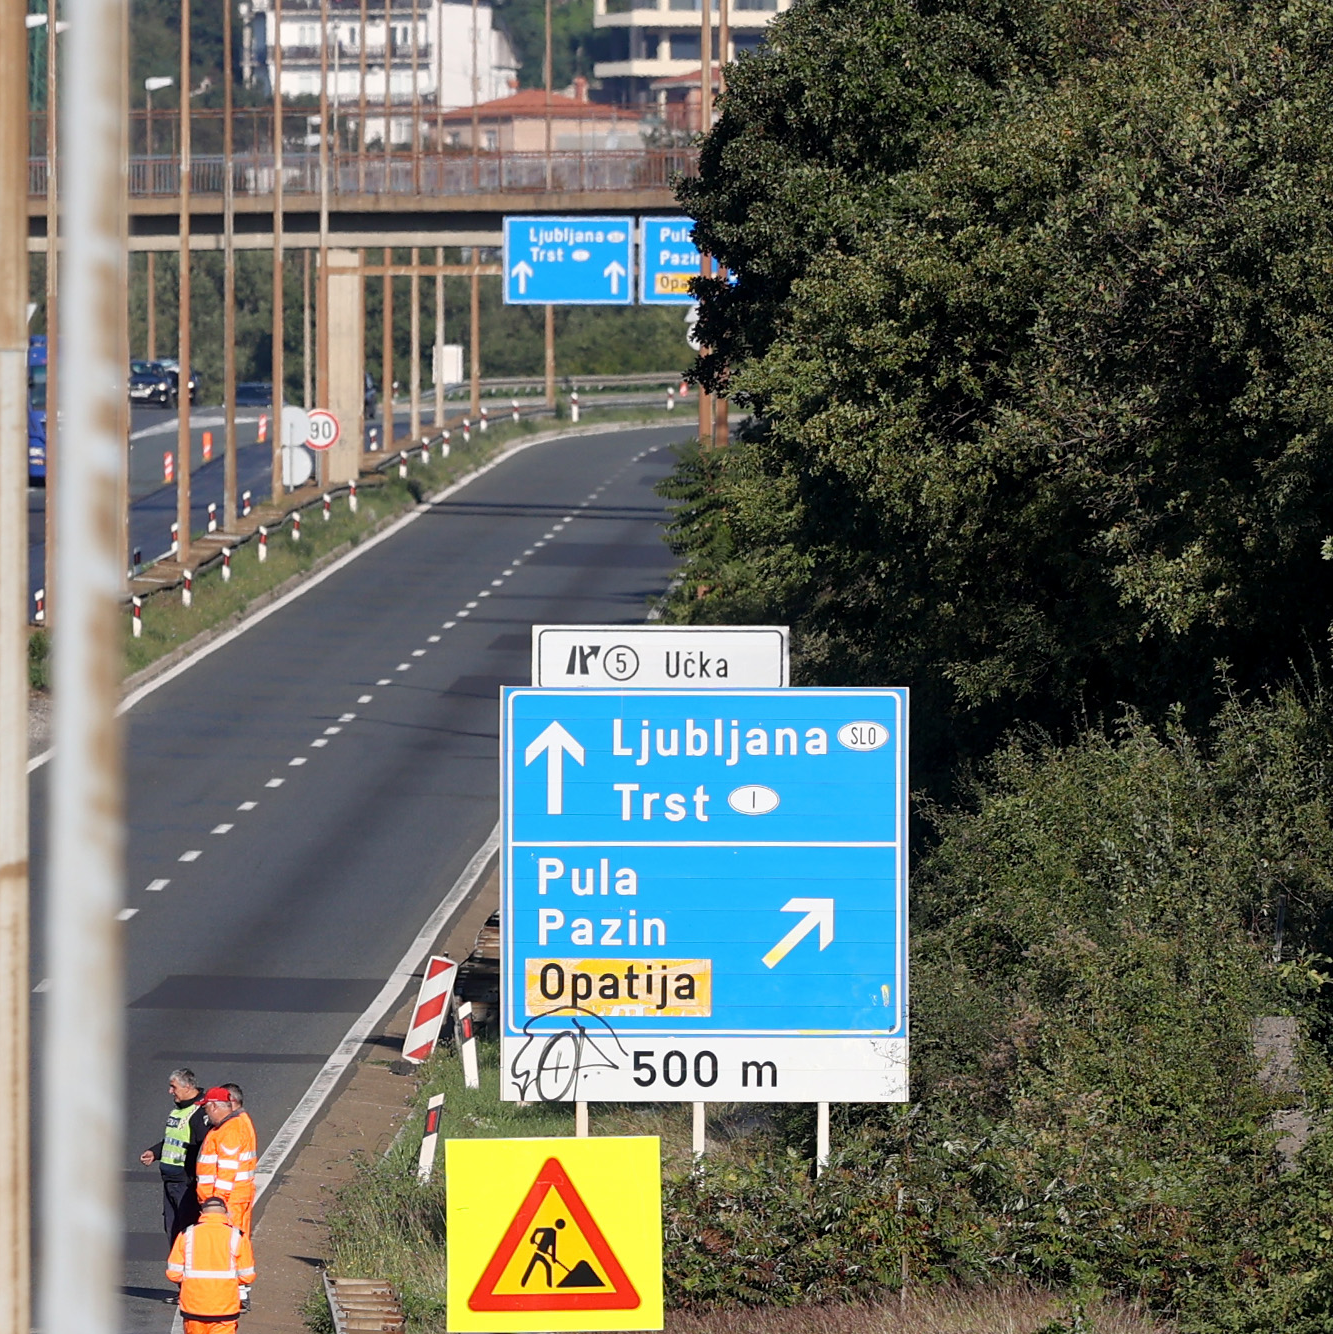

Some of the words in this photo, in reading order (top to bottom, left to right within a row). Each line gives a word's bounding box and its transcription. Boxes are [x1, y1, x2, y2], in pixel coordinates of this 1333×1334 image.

[529, 228, 604, 246] Ljubljana
[529, 247, 564, 262] Trst
[310, 420, 331, 440] 90
[615, 652, 627, 674] 5
[665, 651, 728, 678] Učka
[613, 719, 828, 766] Ljubljana
[850, 727, 877, 746] SLO
[613, 784, 710, 822] Trst
[538, 857, 638, 896] Pula
[538, 908, 666, 946] Pazin
[539, 962, 696, 1009] Opatija
[632, 1050, 719, 1087] 500
[742, 1059, 778, 1087] m
